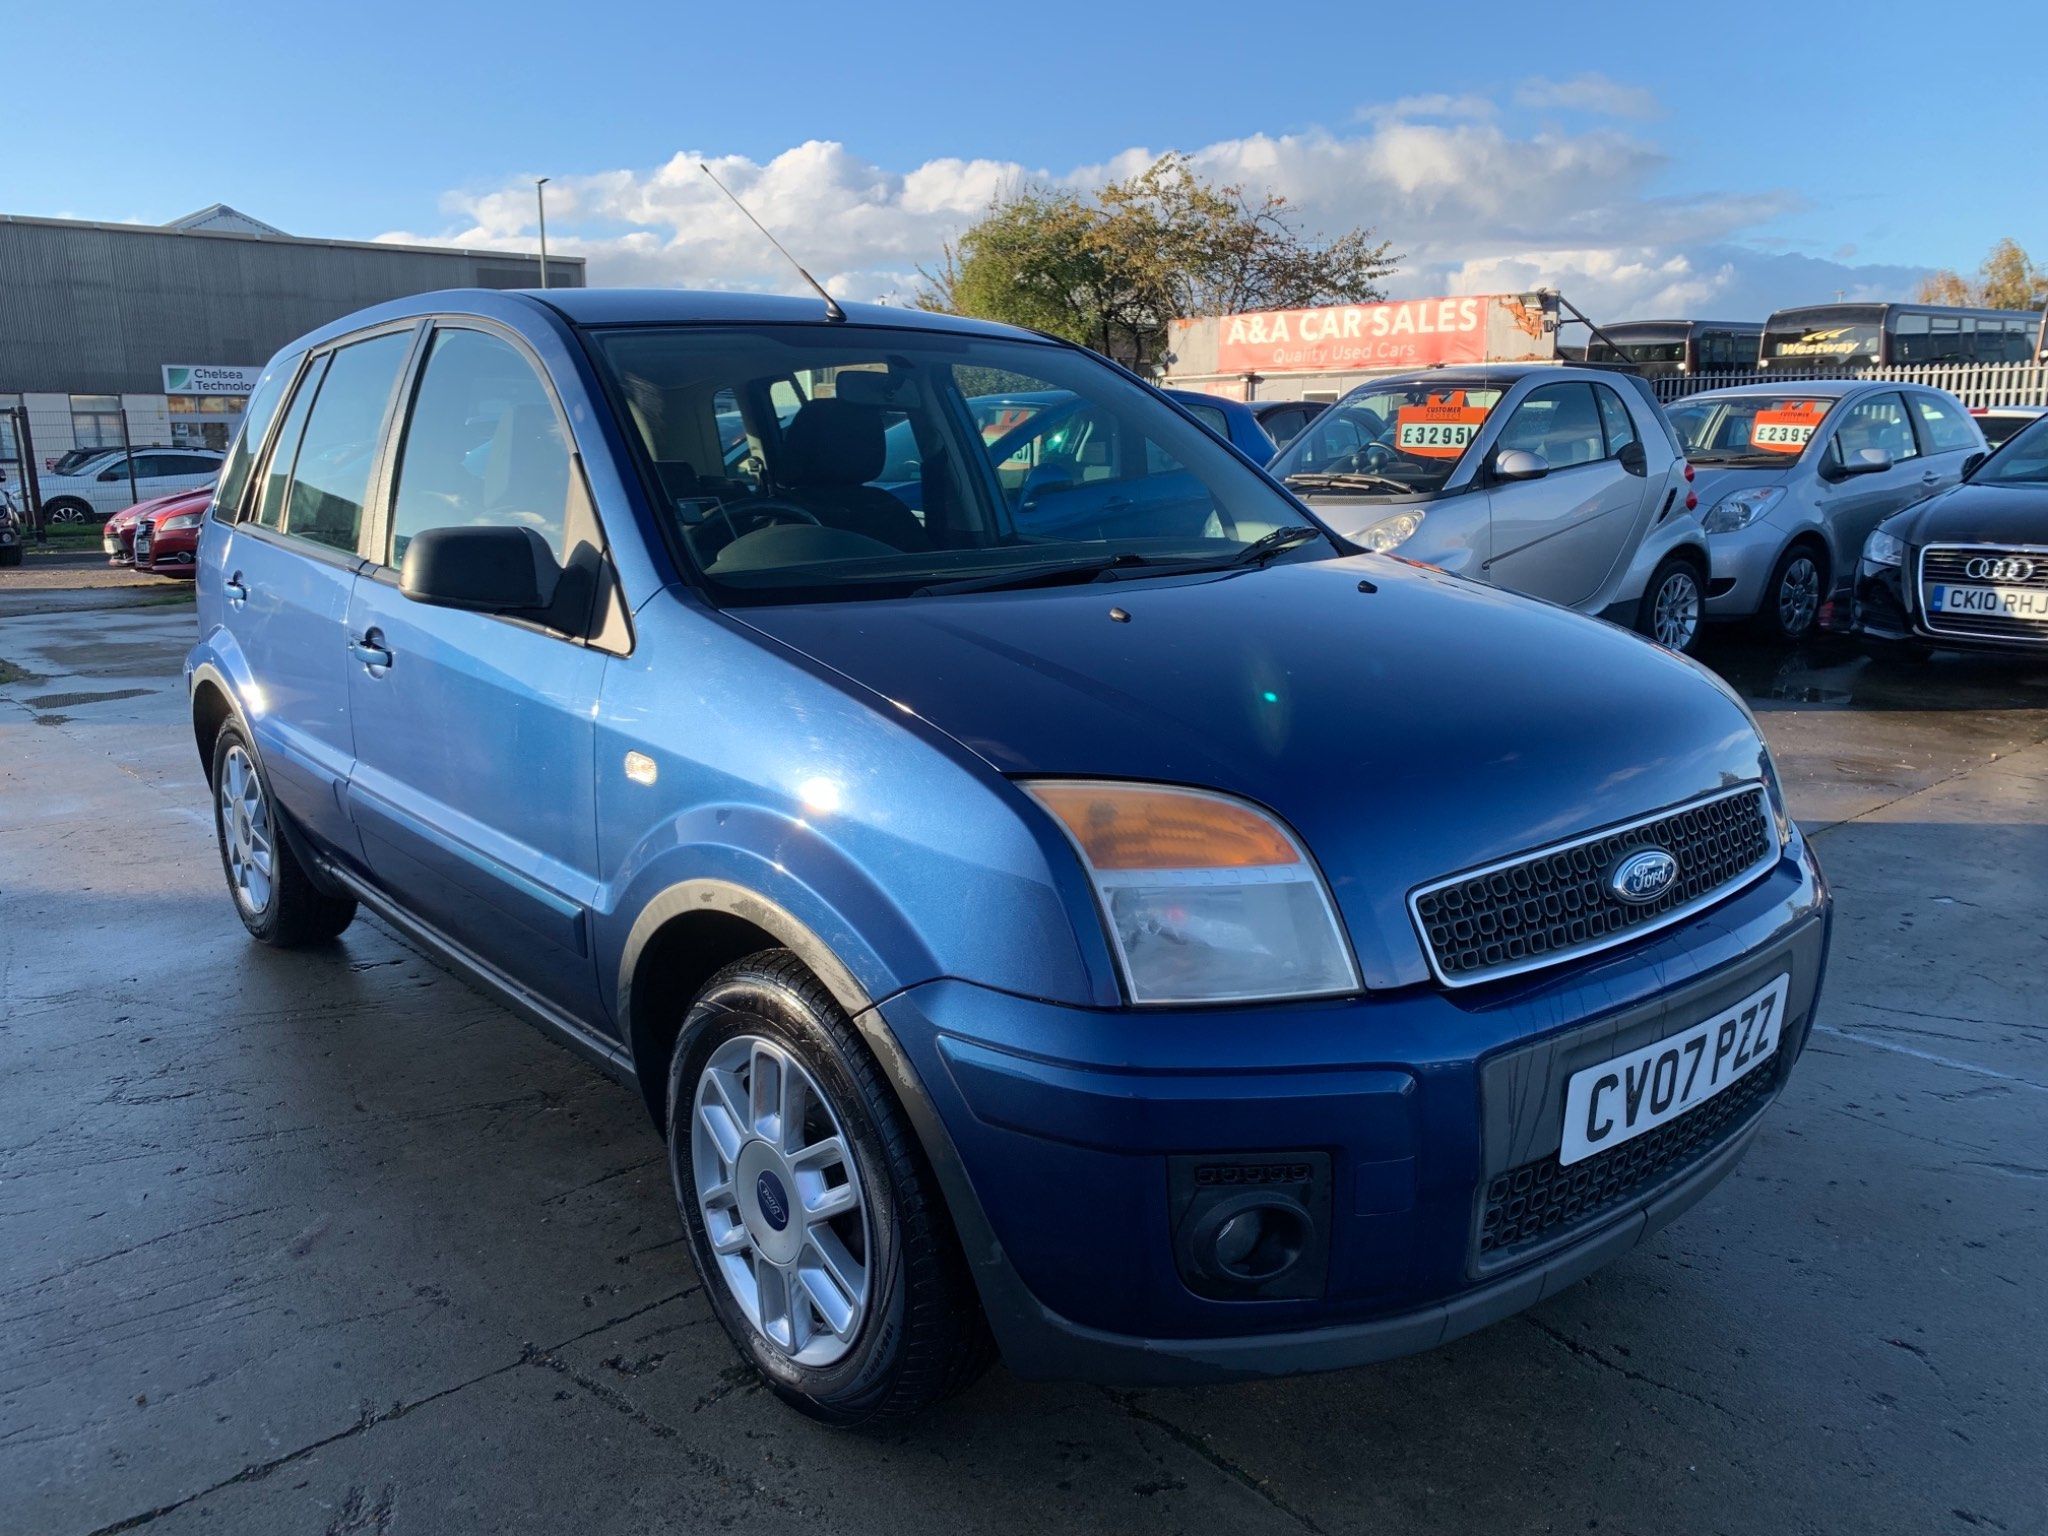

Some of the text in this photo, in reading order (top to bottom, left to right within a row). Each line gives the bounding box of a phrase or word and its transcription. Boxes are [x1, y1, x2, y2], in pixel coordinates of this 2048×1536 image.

[1227, 299, 1479, 346] A&A CAR SALES
[1273, 342, 1415, 364] Quality Used Cars
[1781, 342, 1860, 355] Westway
[194, 368, 243, 379] Chelsea
[1426, 406, 1462, 414] CUSTOMER
[1757, 427, 1812, 443] £2395
[1950, 589, 2048, 614] CK10 RHJ
[1633, 859, 1668, 892] Ford
[1586, 991, 1778, 1143] CV07 PZZ
